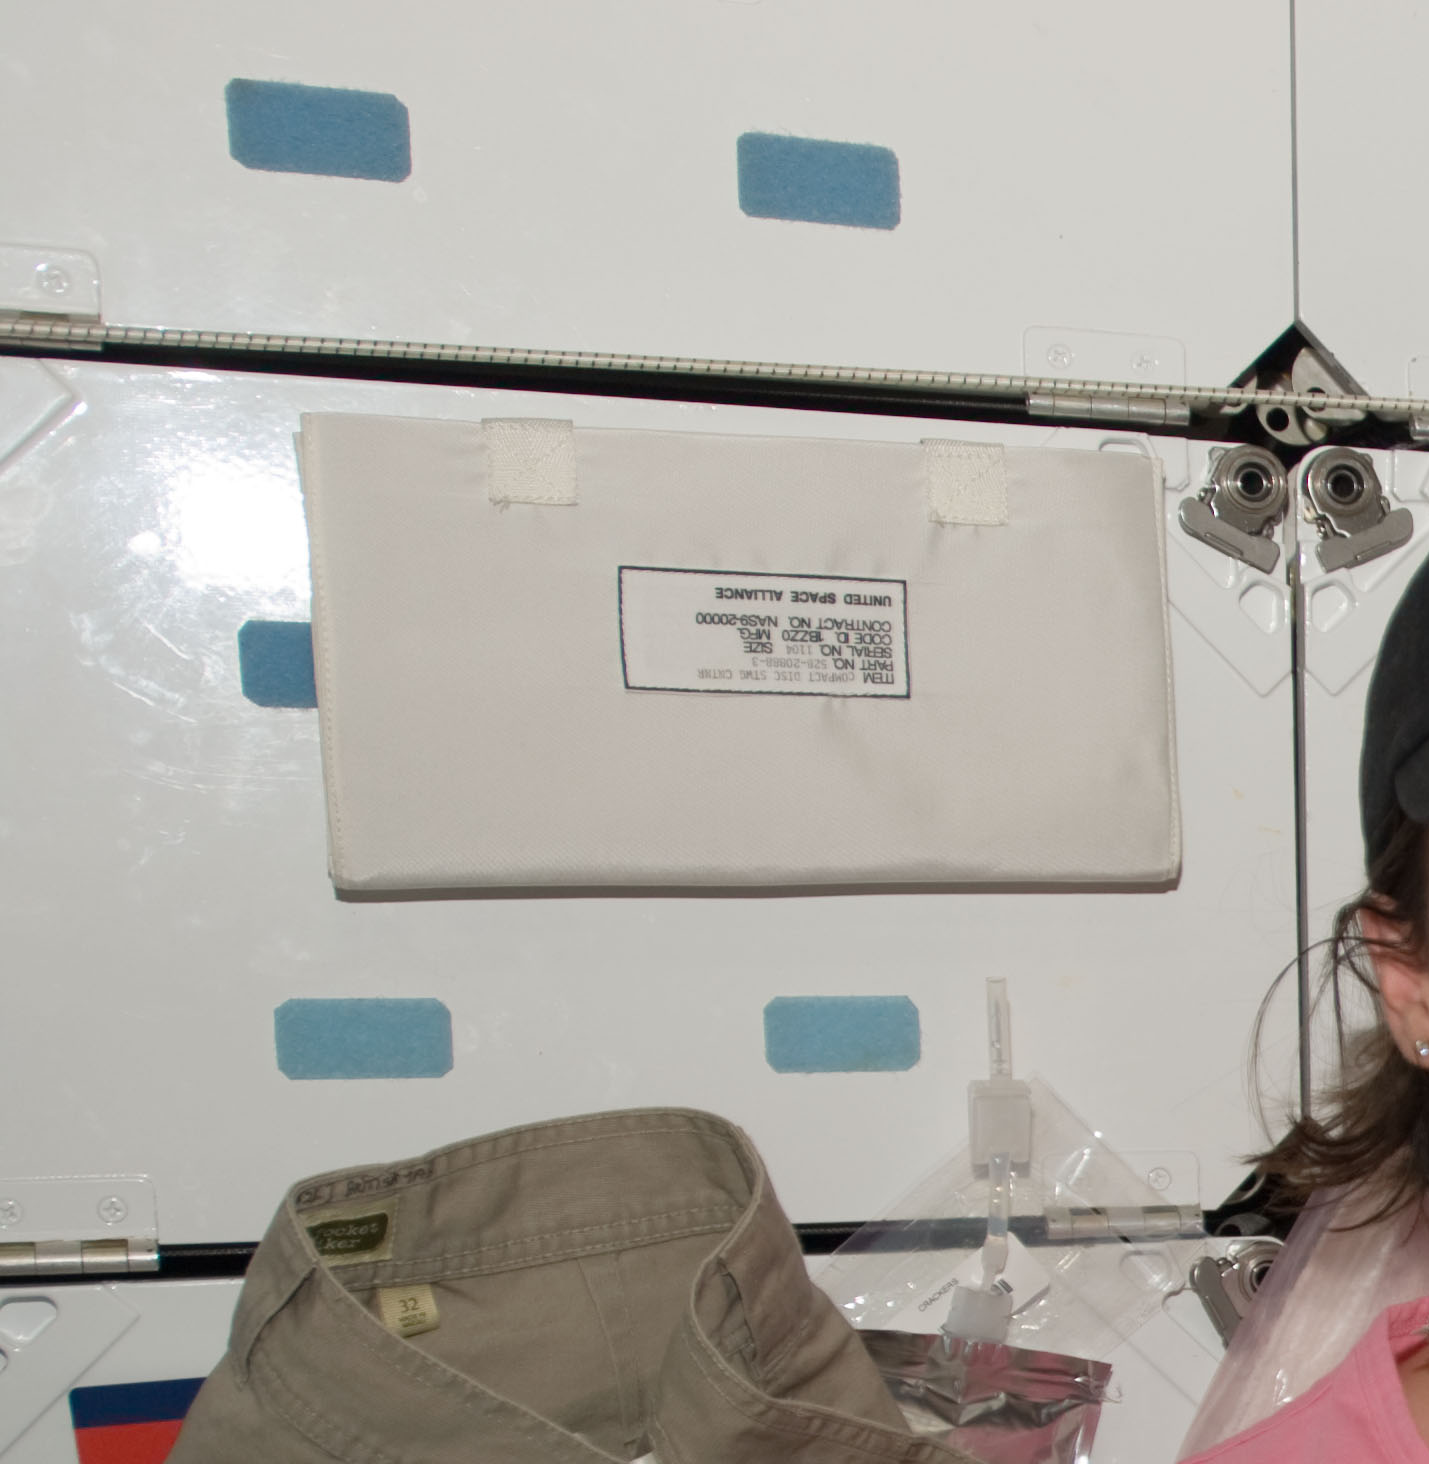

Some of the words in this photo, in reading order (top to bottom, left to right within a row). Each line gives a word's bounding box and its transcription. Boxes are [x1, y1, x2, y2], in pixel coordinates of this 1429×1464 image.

[715, 587, 783, 601] ALLIANCE
[790, 591, 837, 604] SPACE
[843, 594, 892, 607] UNITED
[695, 612, 778, 627] NAS9-20000
[788, 616, 811, 629] NO.
[817, 618, 892, 632] CONTRACT
[737, 628, 770, 641] MFG.
[855, 632, 892, 645] CODE
[743, 641, 773, 654] SIZE
[820, 644, 842, 657] NO.
[846, 645, 893, 658] SERIAL
[832, 657, 855, 670] NO.
[859, 659, 894, 671] PART
[774, 669, 801, 682] DISC
[808, 670, 856, 683] COMPACT
[863, 671, 895, 685] ITEM
[918, 1277, 960, 1313] CRACKERS
[399, 1296, 421, 1313] 32
